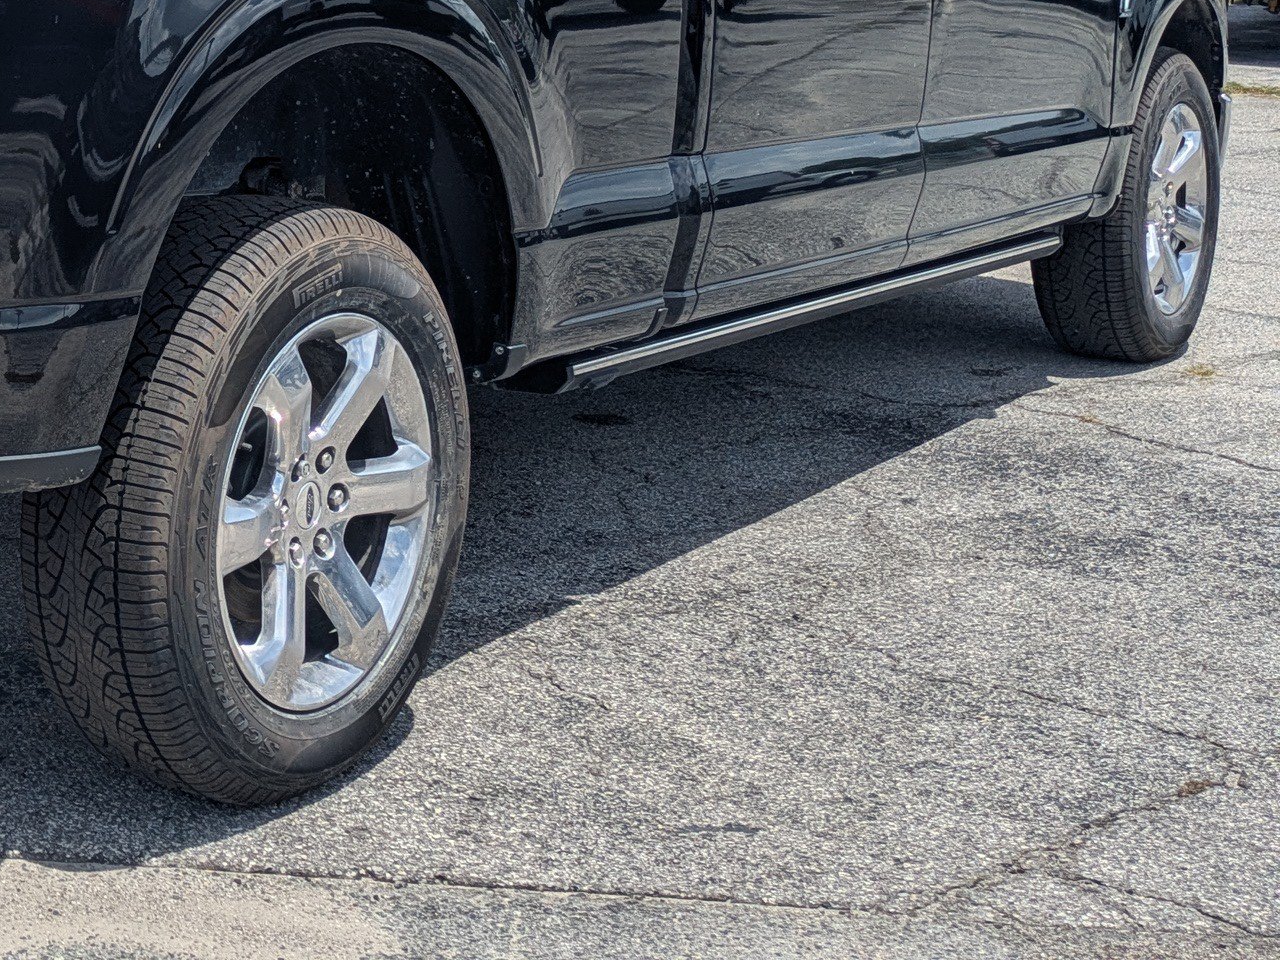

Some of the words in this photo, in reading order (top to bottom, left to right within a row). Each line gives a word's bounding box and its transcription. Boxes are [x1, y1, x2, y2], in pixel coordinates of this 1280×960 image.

[293, 262, 343, 310] PIRELLI
[422, 311, 466, 451] PIRELLI
[194, 578, 280, 759] SCORPION
